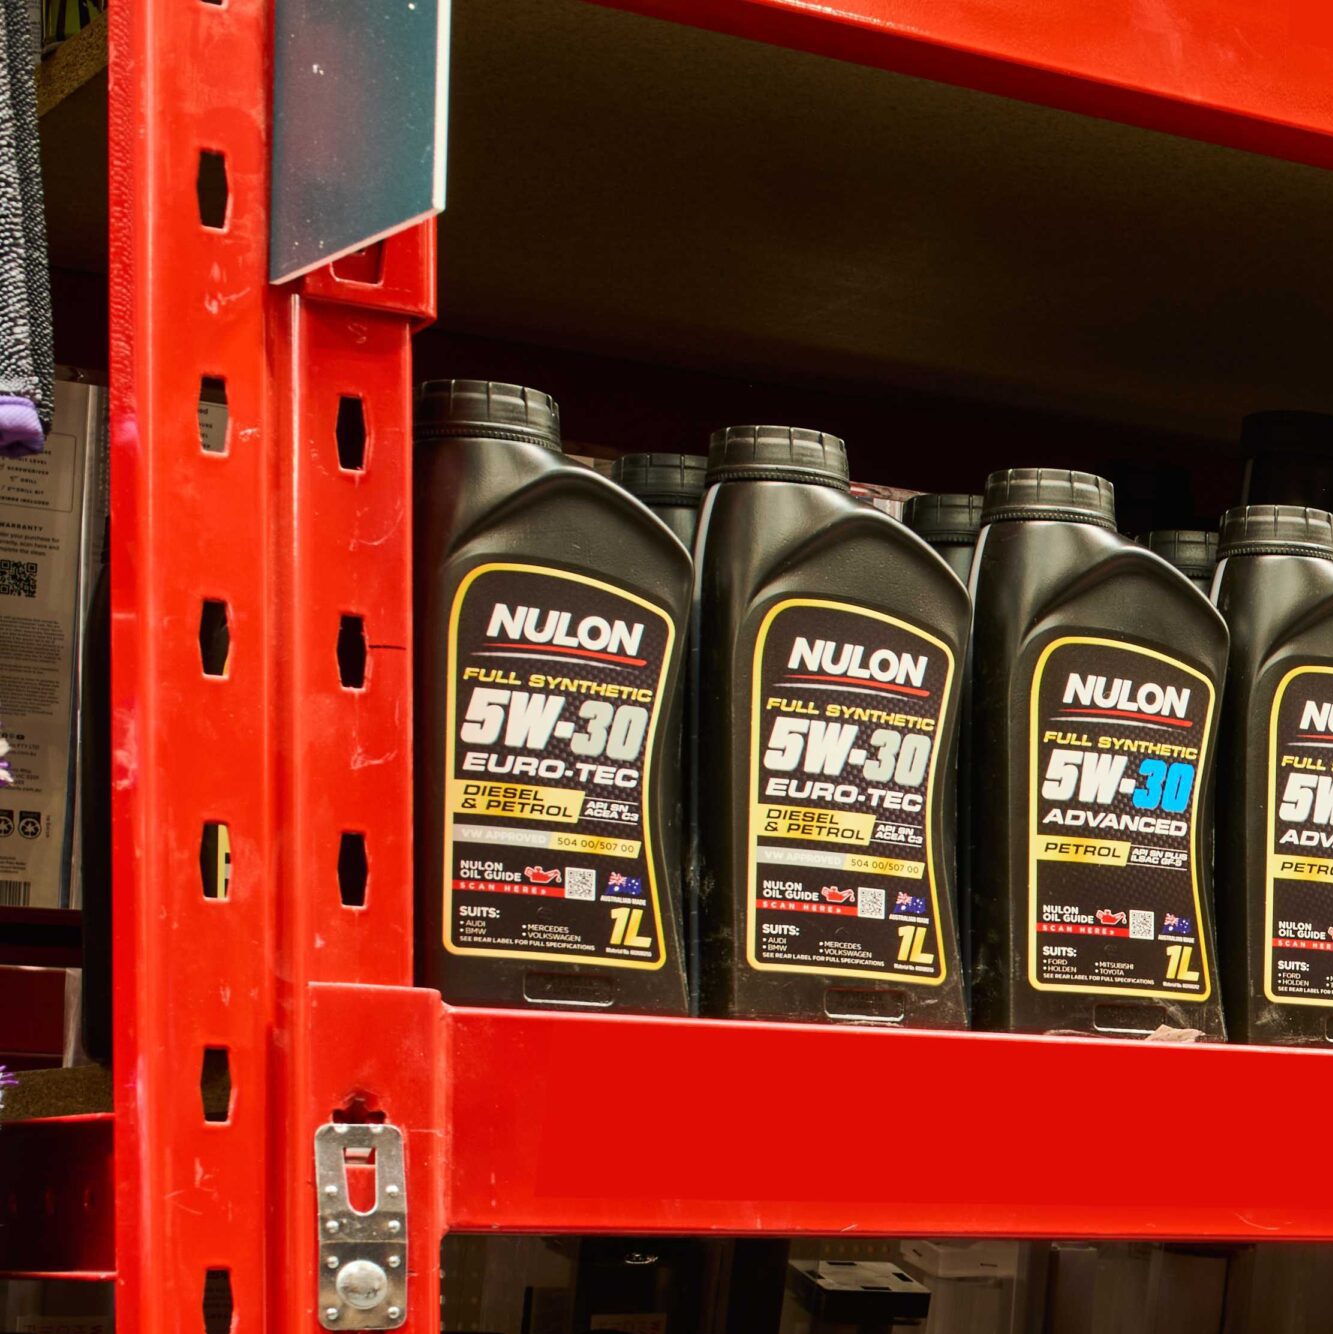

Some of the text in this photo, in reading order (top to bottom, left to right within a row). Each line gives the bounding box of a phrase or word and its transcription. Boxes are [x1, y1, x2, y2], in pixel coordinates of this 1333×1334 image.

[485, 603, 644, 657] NULON
[787, 636, 928, 687] NULON
[462, 667, 654, 703] FULL SYNTHETIC
[1062, 673, 1191, 719] NULON
[460, 687, 649, 763] 5W-30
[461, 752, 639, 790] EURO-TEC
[1041, 748, 1195, 813] 5W-30
[485, 798, 574, 820] PETROL
[459, 905, 500, 919] SUITS:
[609, 907, 652, 948] 1L
